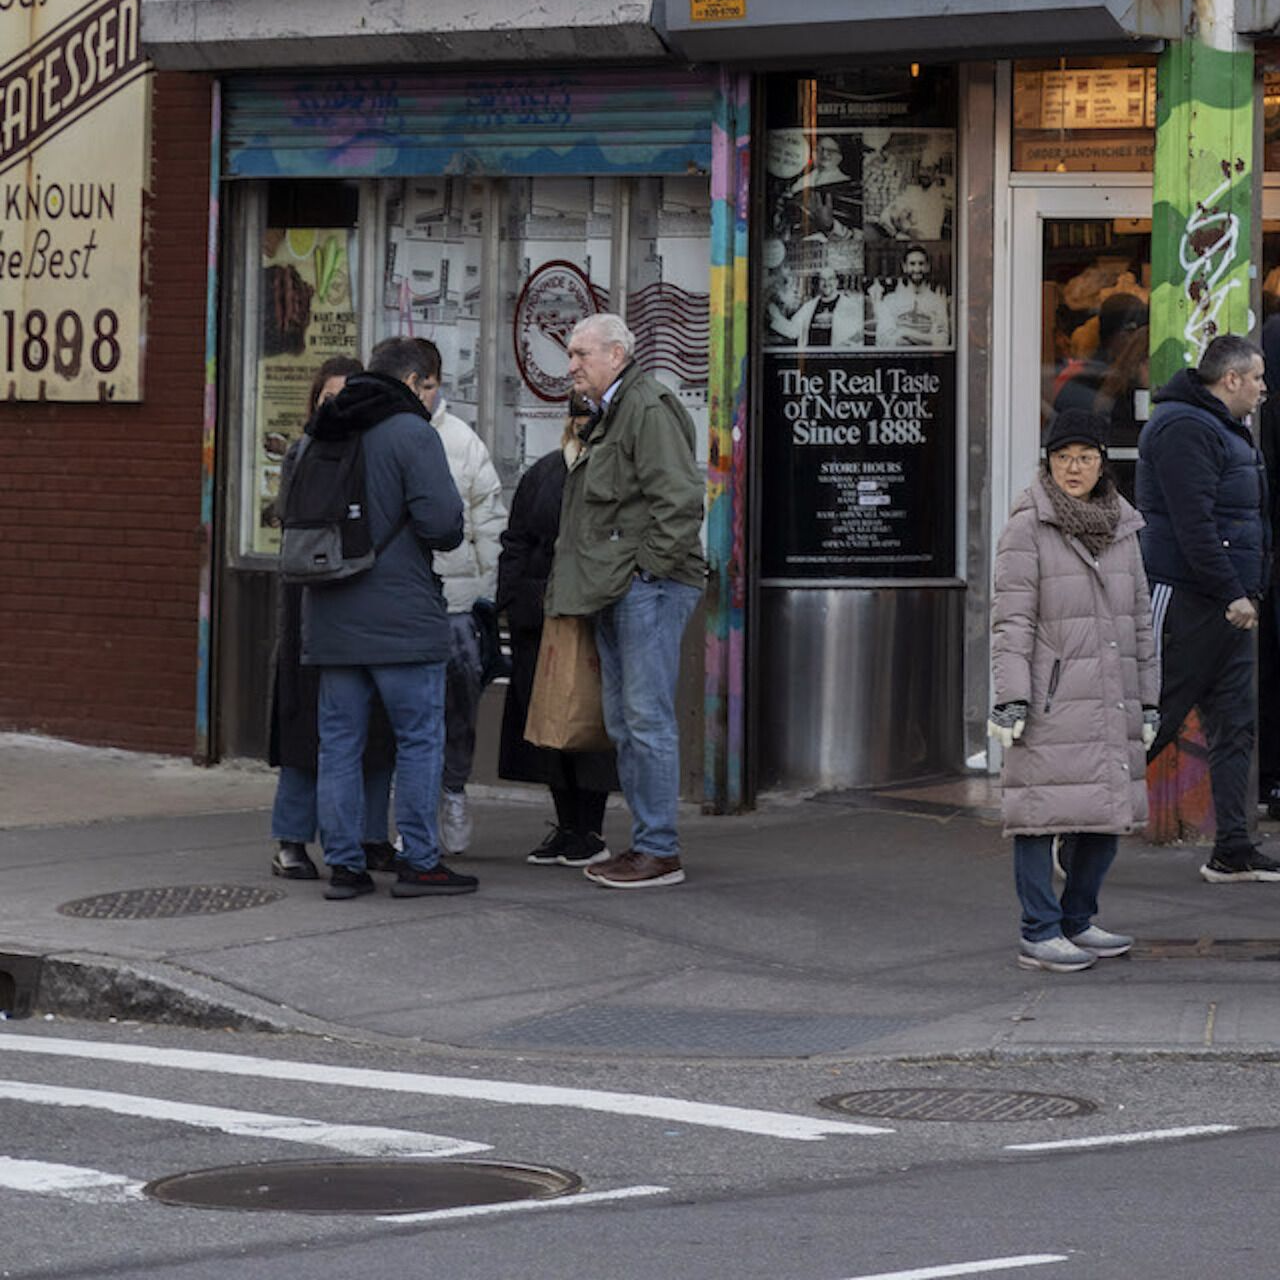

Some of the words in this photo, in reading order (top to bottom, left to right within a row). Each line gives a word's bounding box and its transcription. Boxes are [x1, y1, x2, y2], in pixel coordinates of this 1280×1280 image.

[6, 182, 115, 221] KNOWN
[25, 228, 97, 280] Best
[777, 369, 824, 395] The
[829, 368, 882, 394] Real
[886, 368, 940, 393] Taste
[784, 394, 811, 421] of
[815, 395, 873, 419] New
[876, 394, 933, 419] York.
[792, 419, 861, 445] Since
[867, 419, 927, 445] 1888.
[821, 462, 860, 474] STORE
[862, 462, 903, 474] HOURS
